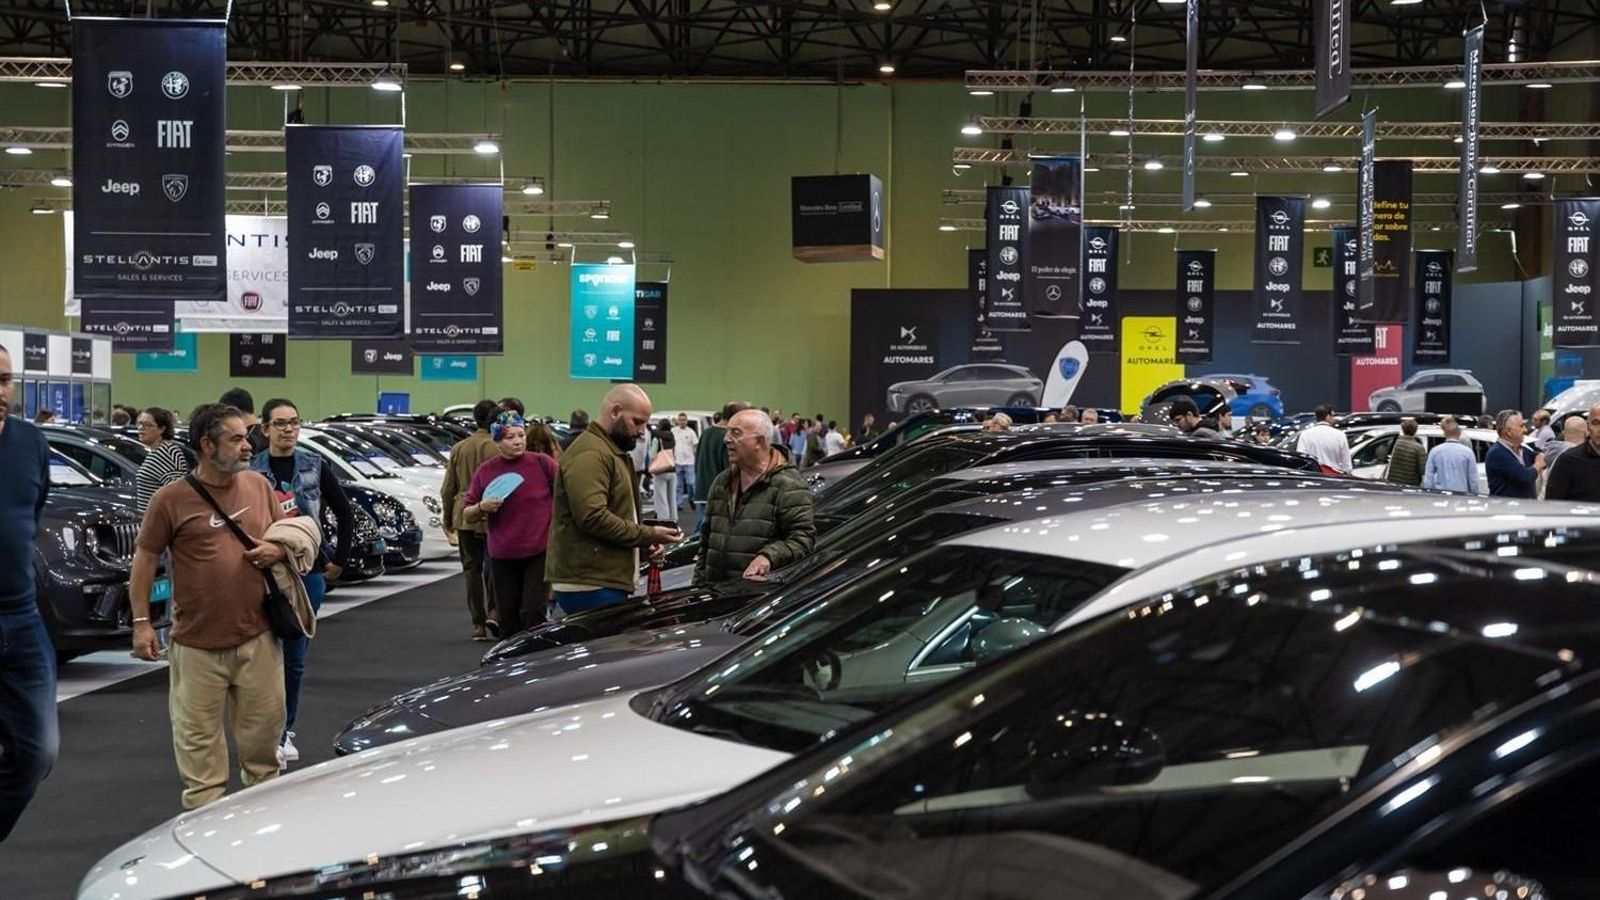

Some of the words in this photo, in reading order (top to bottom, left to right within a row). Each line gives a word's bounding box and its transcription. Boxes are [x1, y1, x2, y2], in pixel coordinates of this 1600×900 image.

[157, 121, 194, 148] FIAT
[102, 179, 140, 196] Jeep
[351, 202, 379, 224] FIAT
[999, 225, 1020, 240] FIAT
[1269, 235, 1290, 251] FIAT
[1567, 237, 1590, 252] FIAT
[83, 253, 190, 267] STELLANTIS
[309, 247, 339, 261] Jeep
[461, 244, 483, 262] FIAT
[1088, 258, 1107, 272] FIAT
[996, 271, 1021, 282] Jeep
[427, 280, 451, 292] Jeep
[1266, 281, 1290, 293] Jeep
[1565, 284, 1592, 294] Jeep
[295, 304, 376, 315] STELLANTIS
[1086, 299, 1108, 308] Jeep
[883, 356, 935, 364] AUTOMARES
[1355, 357, 1399, 366] AUTOMARES
